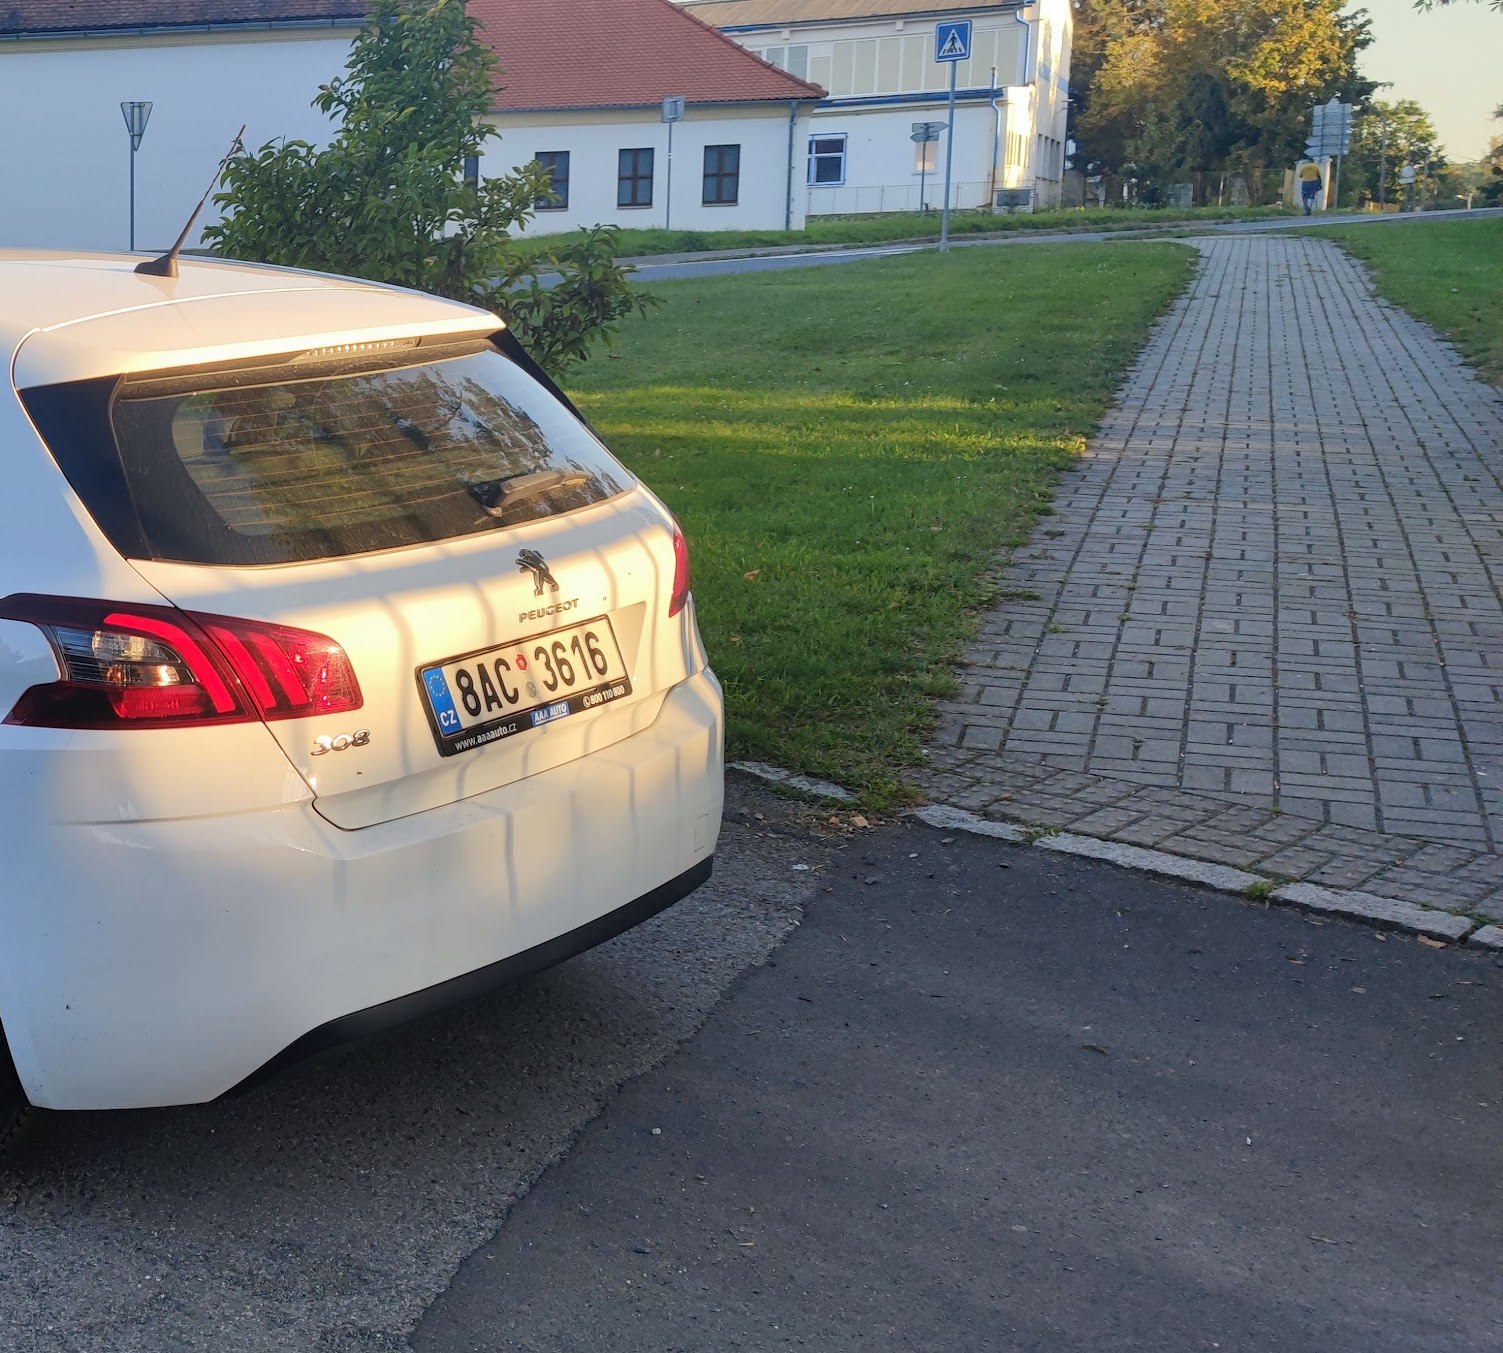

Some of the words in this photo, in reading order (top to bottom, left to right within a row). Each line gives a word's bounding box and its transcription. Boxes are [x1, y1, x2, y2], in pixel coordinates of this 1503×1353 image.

[518, 598, 579, 623] PEUGEOT
[455, 657, 520, 717] 8AC
[534, 631, 608, 692] 3616
[590, 691, 603, 705] 800
[439, 709, 457, 727] CZ
[534, 709, 549, 723] AAA
[549, 703, 567, 717] AUTO
[310, 728, 371, 757] 308
[454, 722, 517, 751] www.aaaauto.cz
